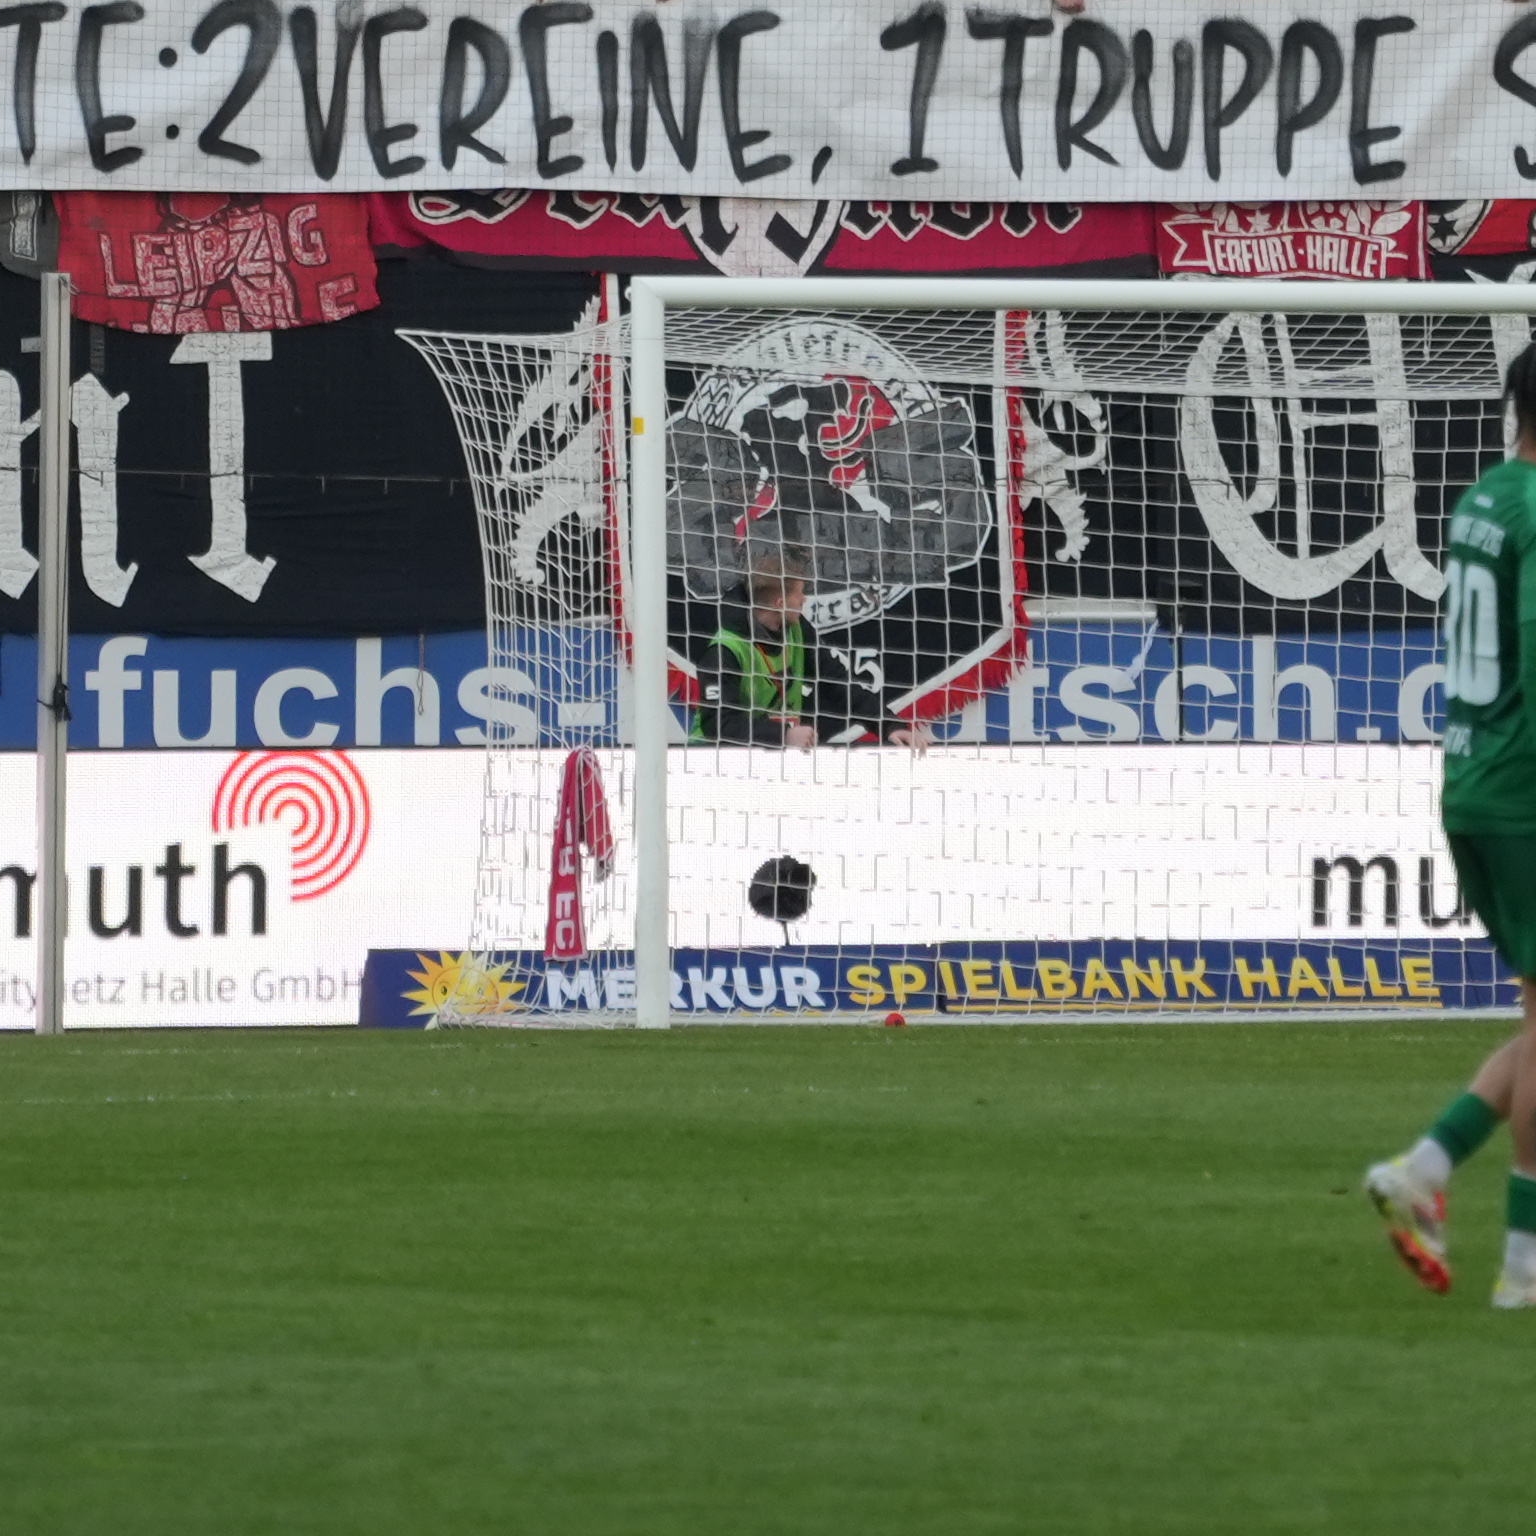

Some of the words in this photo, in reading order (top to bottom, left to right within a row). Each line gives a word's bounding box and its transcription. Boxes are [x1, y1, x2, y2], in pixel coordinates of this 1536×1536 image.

[141, 964, 238, 1005] Halle
[846, 957, 1216, 1006] SPIELBANK
[1234, 956, 1441, 999] HALLE
